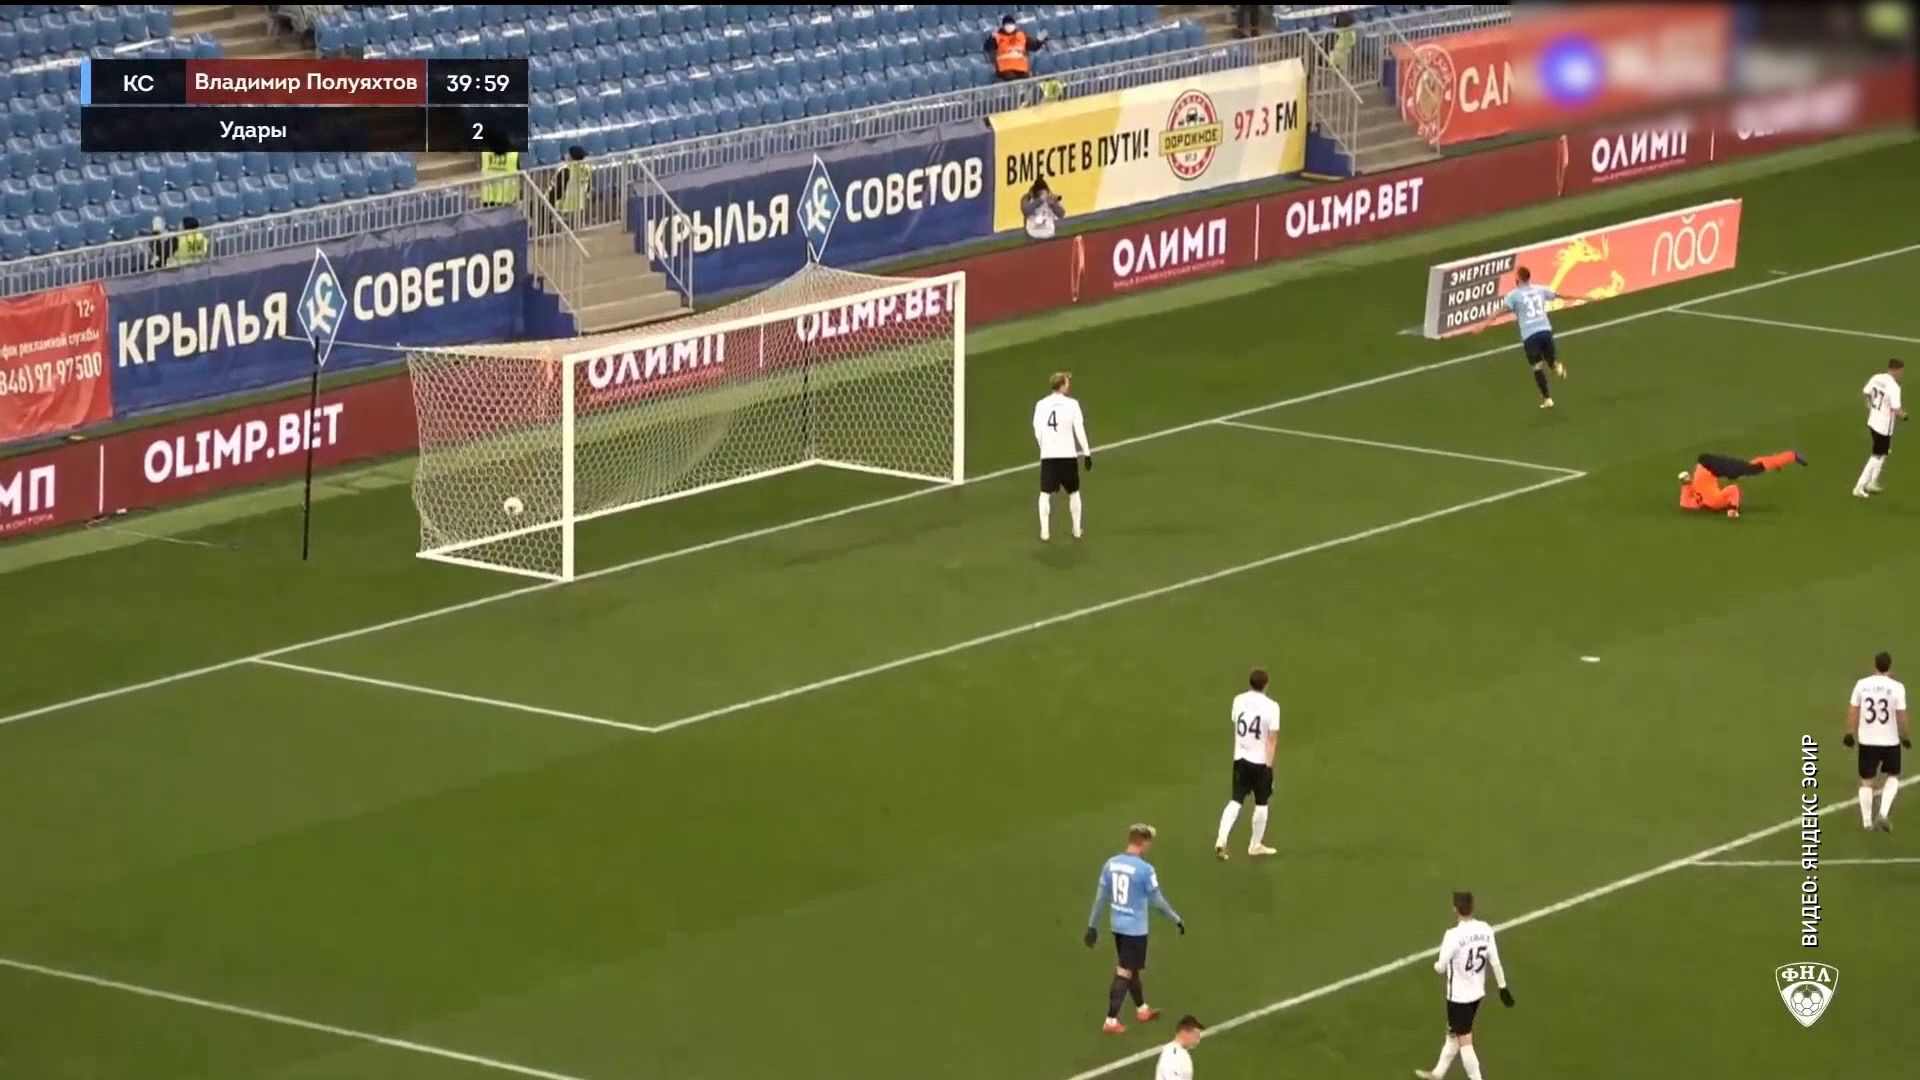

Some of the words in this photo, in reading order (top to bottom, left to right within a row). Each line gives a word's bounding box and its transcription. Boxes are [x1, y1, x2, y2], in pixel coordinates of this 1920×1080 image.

[1234, 106, 1271, 140] 97.3
[1276, 100, 1299, 134] FM
[1006, 142, 1077, 186] ВМЕСТЕ
[1081, 140, 1093, 170] В
[1097, 128, 1150, 168] ПУТИ!
[647, 194, 789, 261] КРЫЛЬЯ
[846, 156, 983, 223] СОВЕТОВ
[1285, 177, 1424, 239] OLIMP.BET
[1112, 217, 1227, 277] ОЛИМП
[1449, 258, 1512, 287] ЭНЕРГЕТИК
[118, 291, 289, 368] КРЫЛЬЯ
[354, 248, 516, 322] СОВЕТОВ
[1448, 281, 1495, 307] НОВОГО
[587, 330, 726, 389] ОЛИМП
[1047, 410, 1058, 432] 4
[143, 403, 344, 484] OLIMP.BET
[1237, 711, 1262, 740] 64
[1864, 697, 1890, 725] 33
[1112, 872, 1130, 905] 19
[1465, 946, 1487, 977] 45
